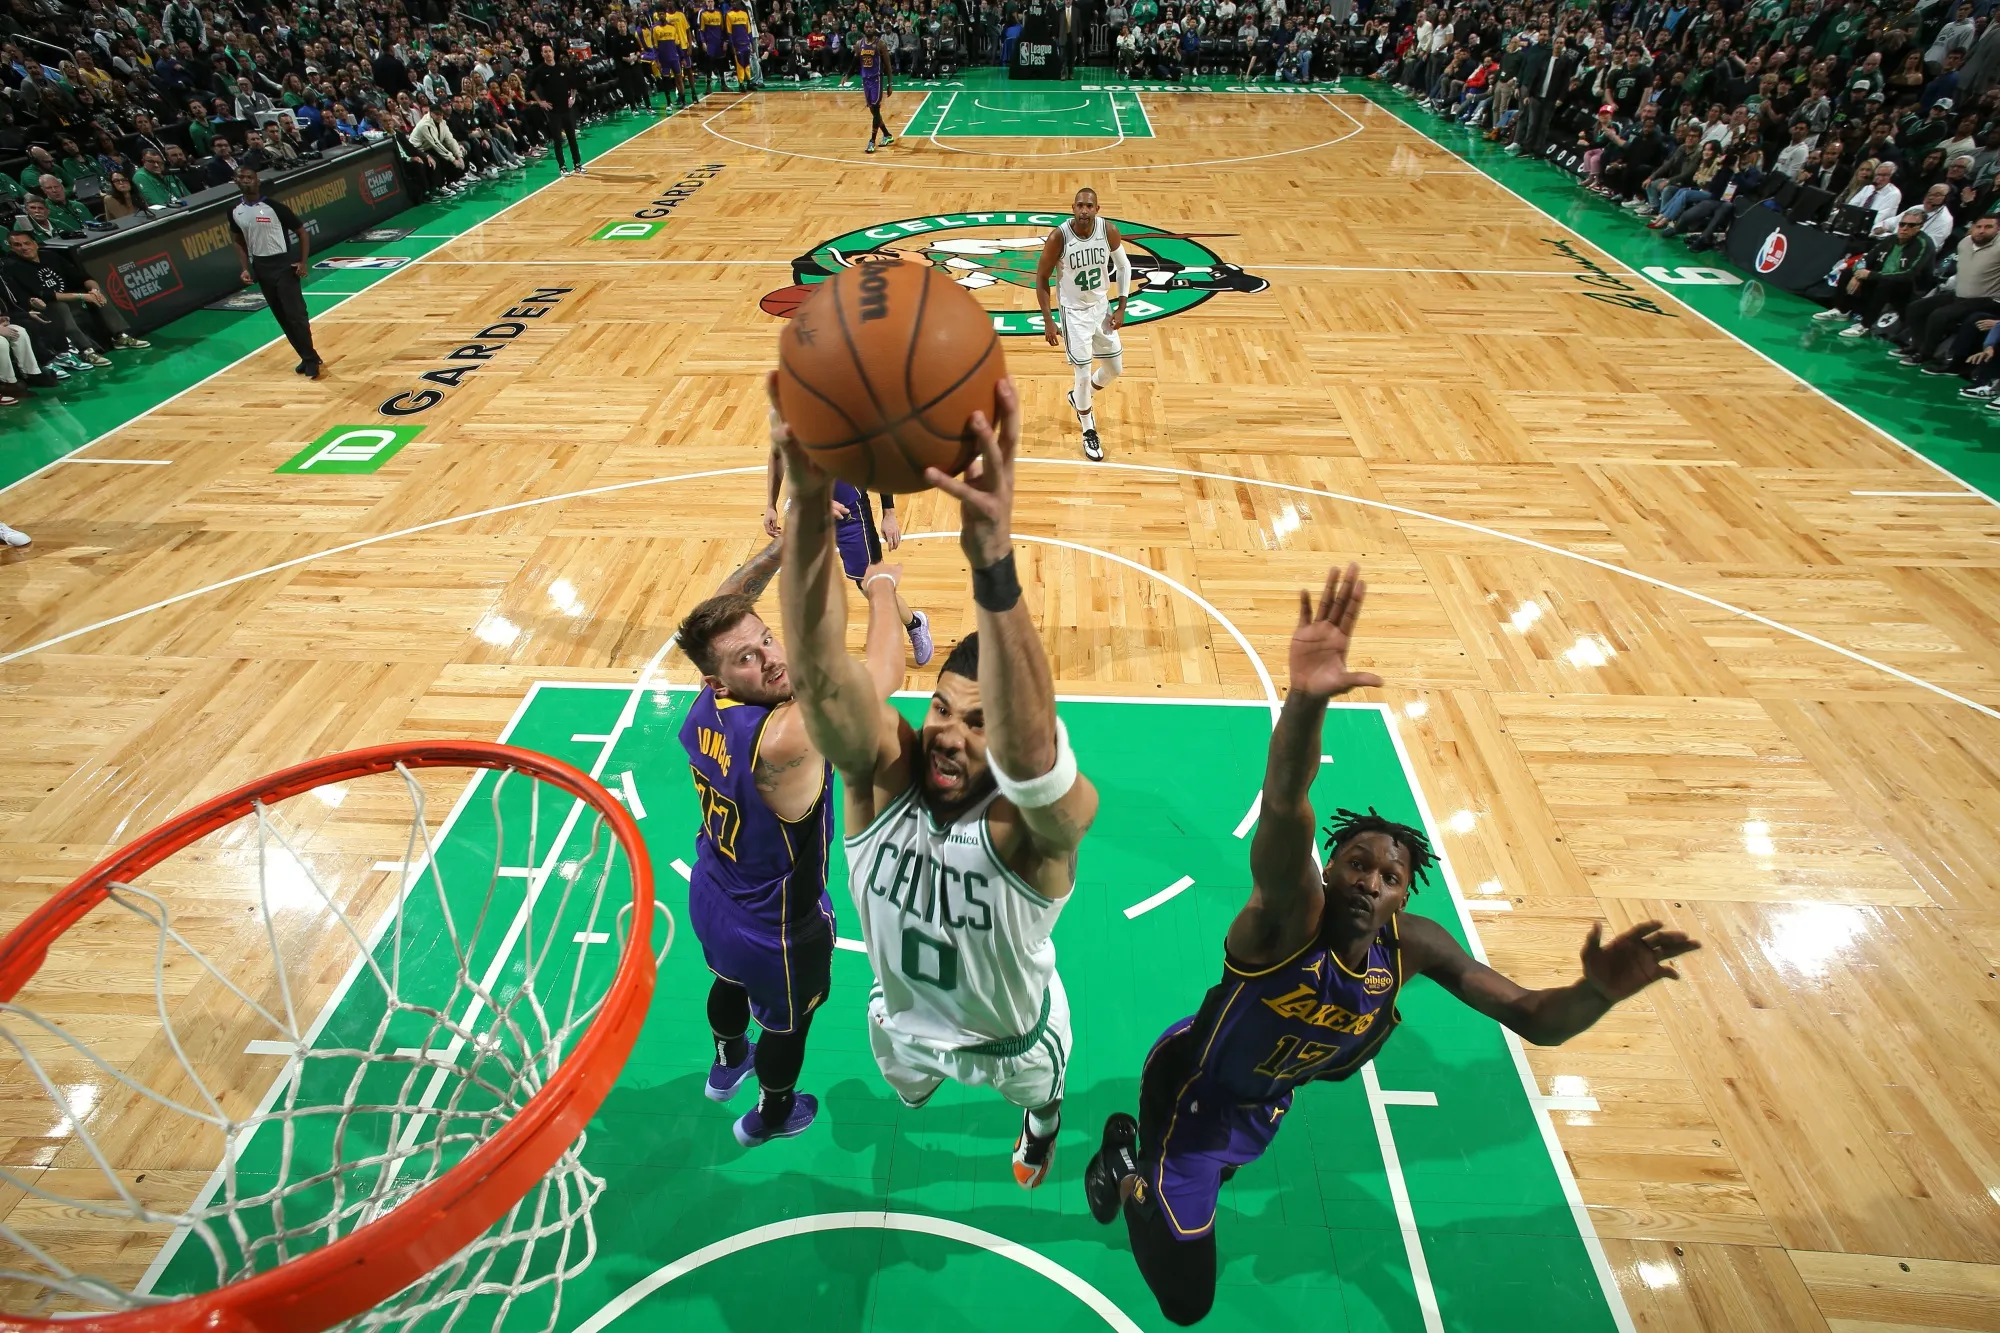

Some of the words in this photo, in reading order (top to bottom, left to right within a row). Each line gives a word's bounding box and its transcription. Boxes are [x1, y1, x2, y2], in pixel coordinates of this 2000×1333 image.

[1030, 43, 1052, 55] League
[1030, 54, 1046, 65] Pass
[368, 170, 393, 189] CHAMP
[370, 184, 388, 198] WEEK
[281, 177, 346, 216] HAMPIONSHIP
[602, 223, 655, 239] TD
[633, 163, 728, 220] GARDEN
[864, 213, 1056, 239] CELTIC
[1069, 247, 1105, 270] CELTICS
[123, 260, 170, 288] CHAMP
[1074, 267, 1101, 291] 42
[129, 280, 162, 300] WEEK
[298, 429, 397, 470] TD
[377, 286, 579, 417] GARDEN
[690, 763, 741, 863] 77
[948, 831, 980, 846] mica
[868, 841, 993, 931] CELTCS
[901, 926, 958, 991] 0
[1253, 1034, 1341, 1080] 17
